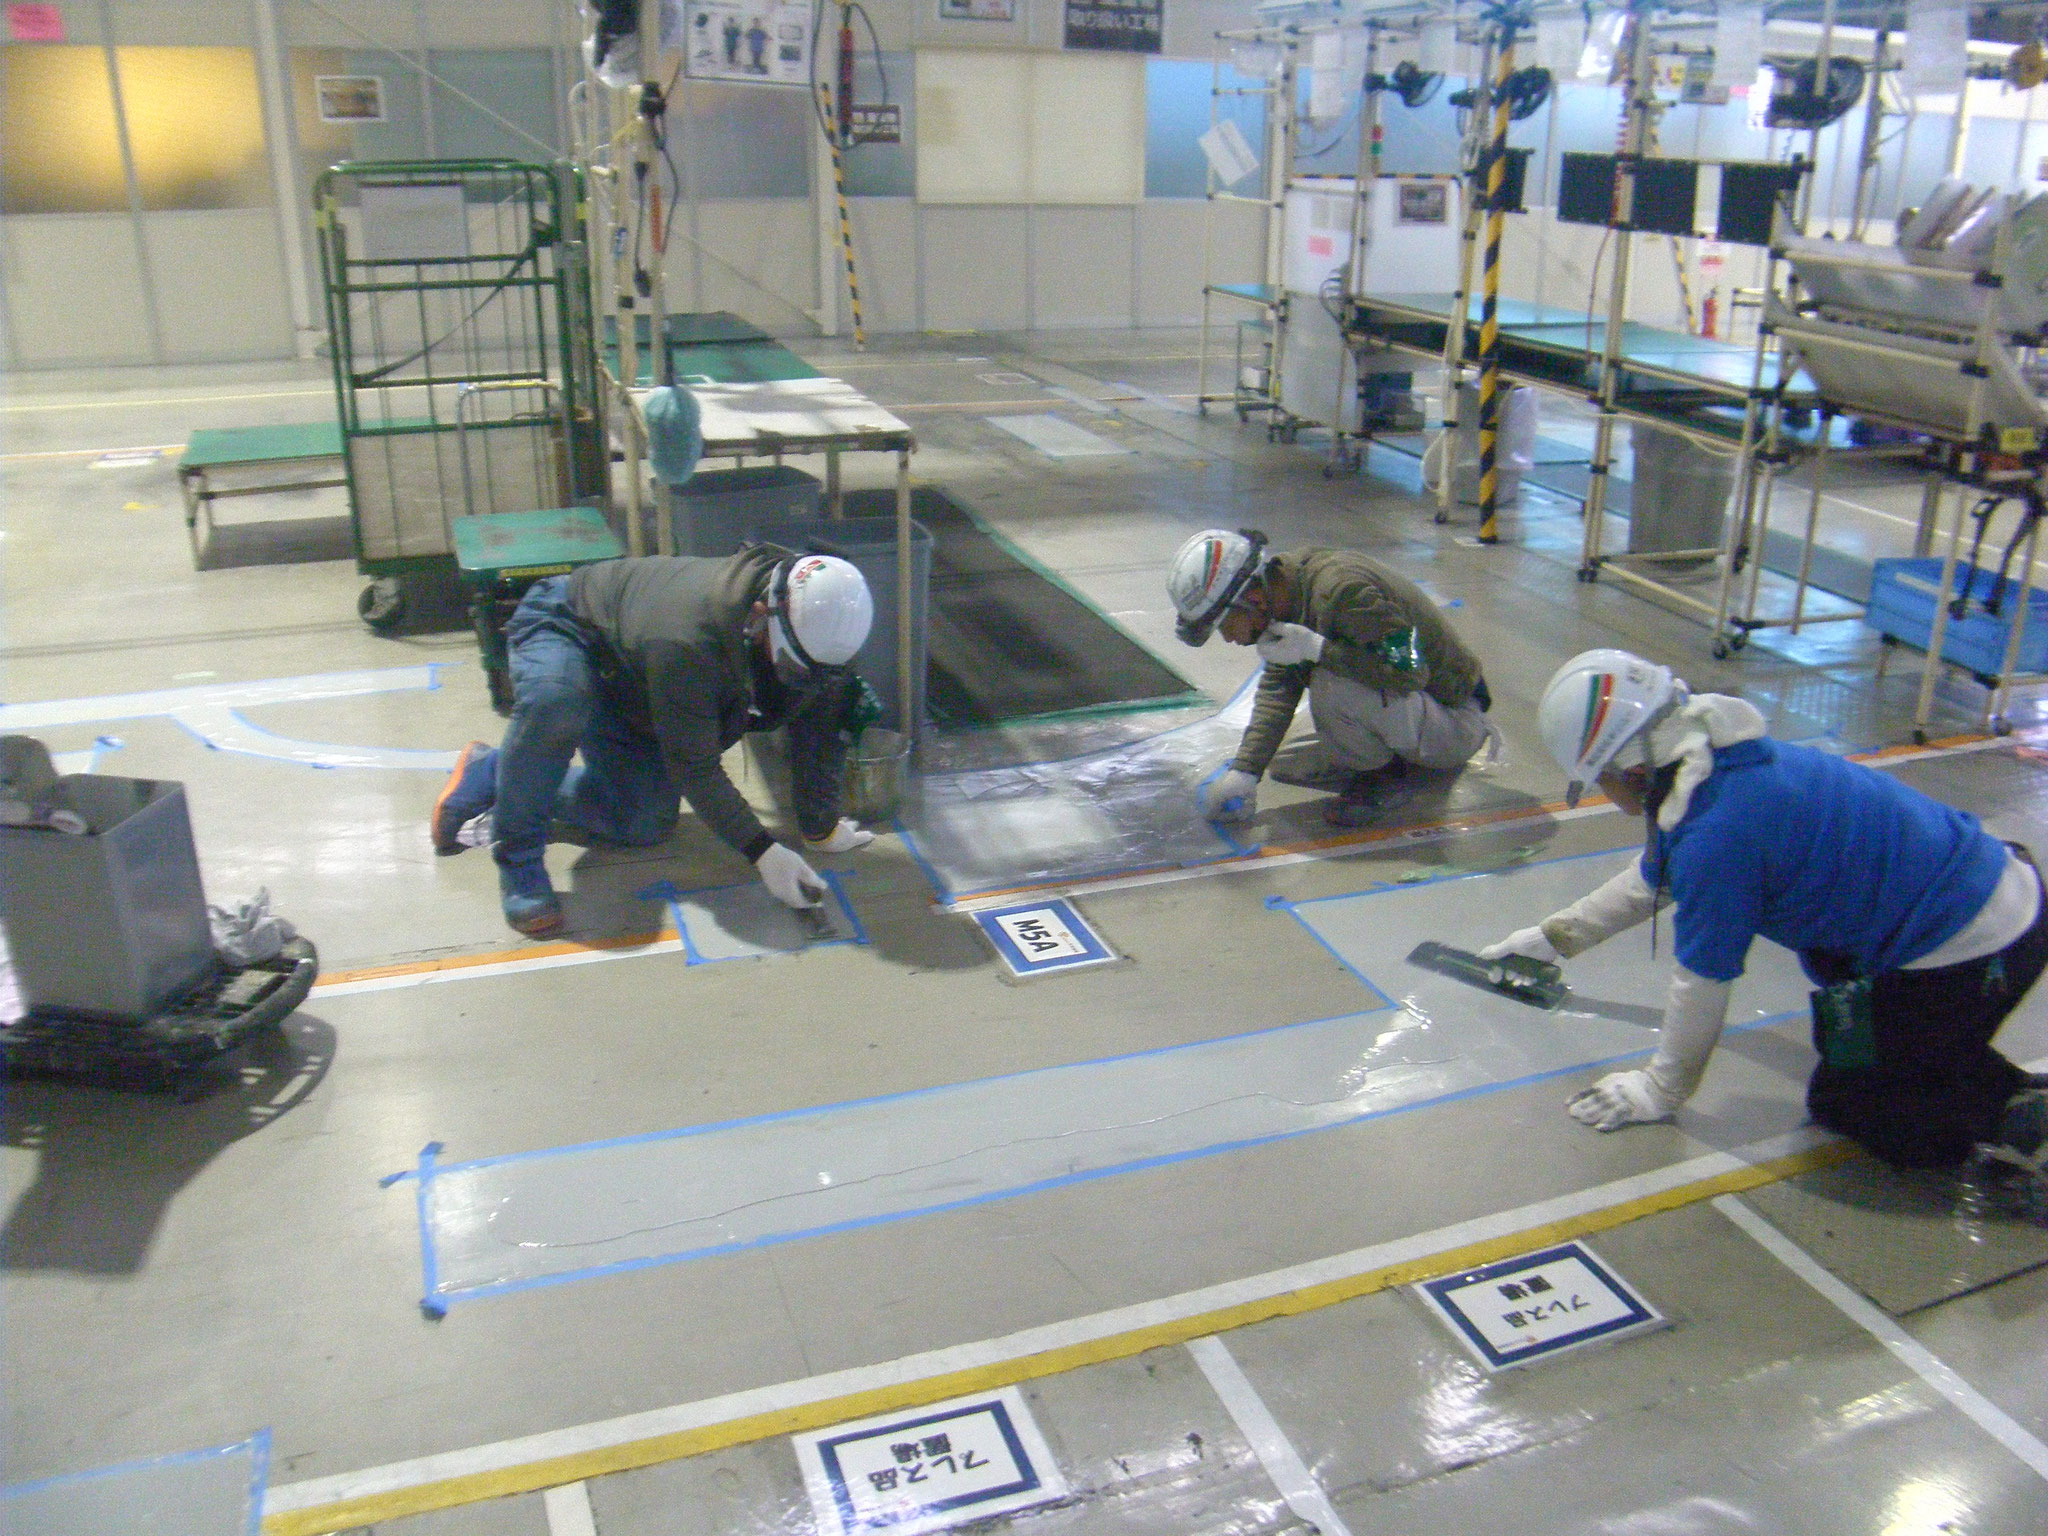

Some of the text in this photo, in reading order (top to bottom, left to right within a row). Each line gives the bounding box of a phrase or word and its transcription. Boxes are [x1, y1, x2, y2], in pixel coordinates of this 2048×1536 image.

[1012, 918, 1060, 953] M5A
[867, 1450, 990, 1492] プレス品
